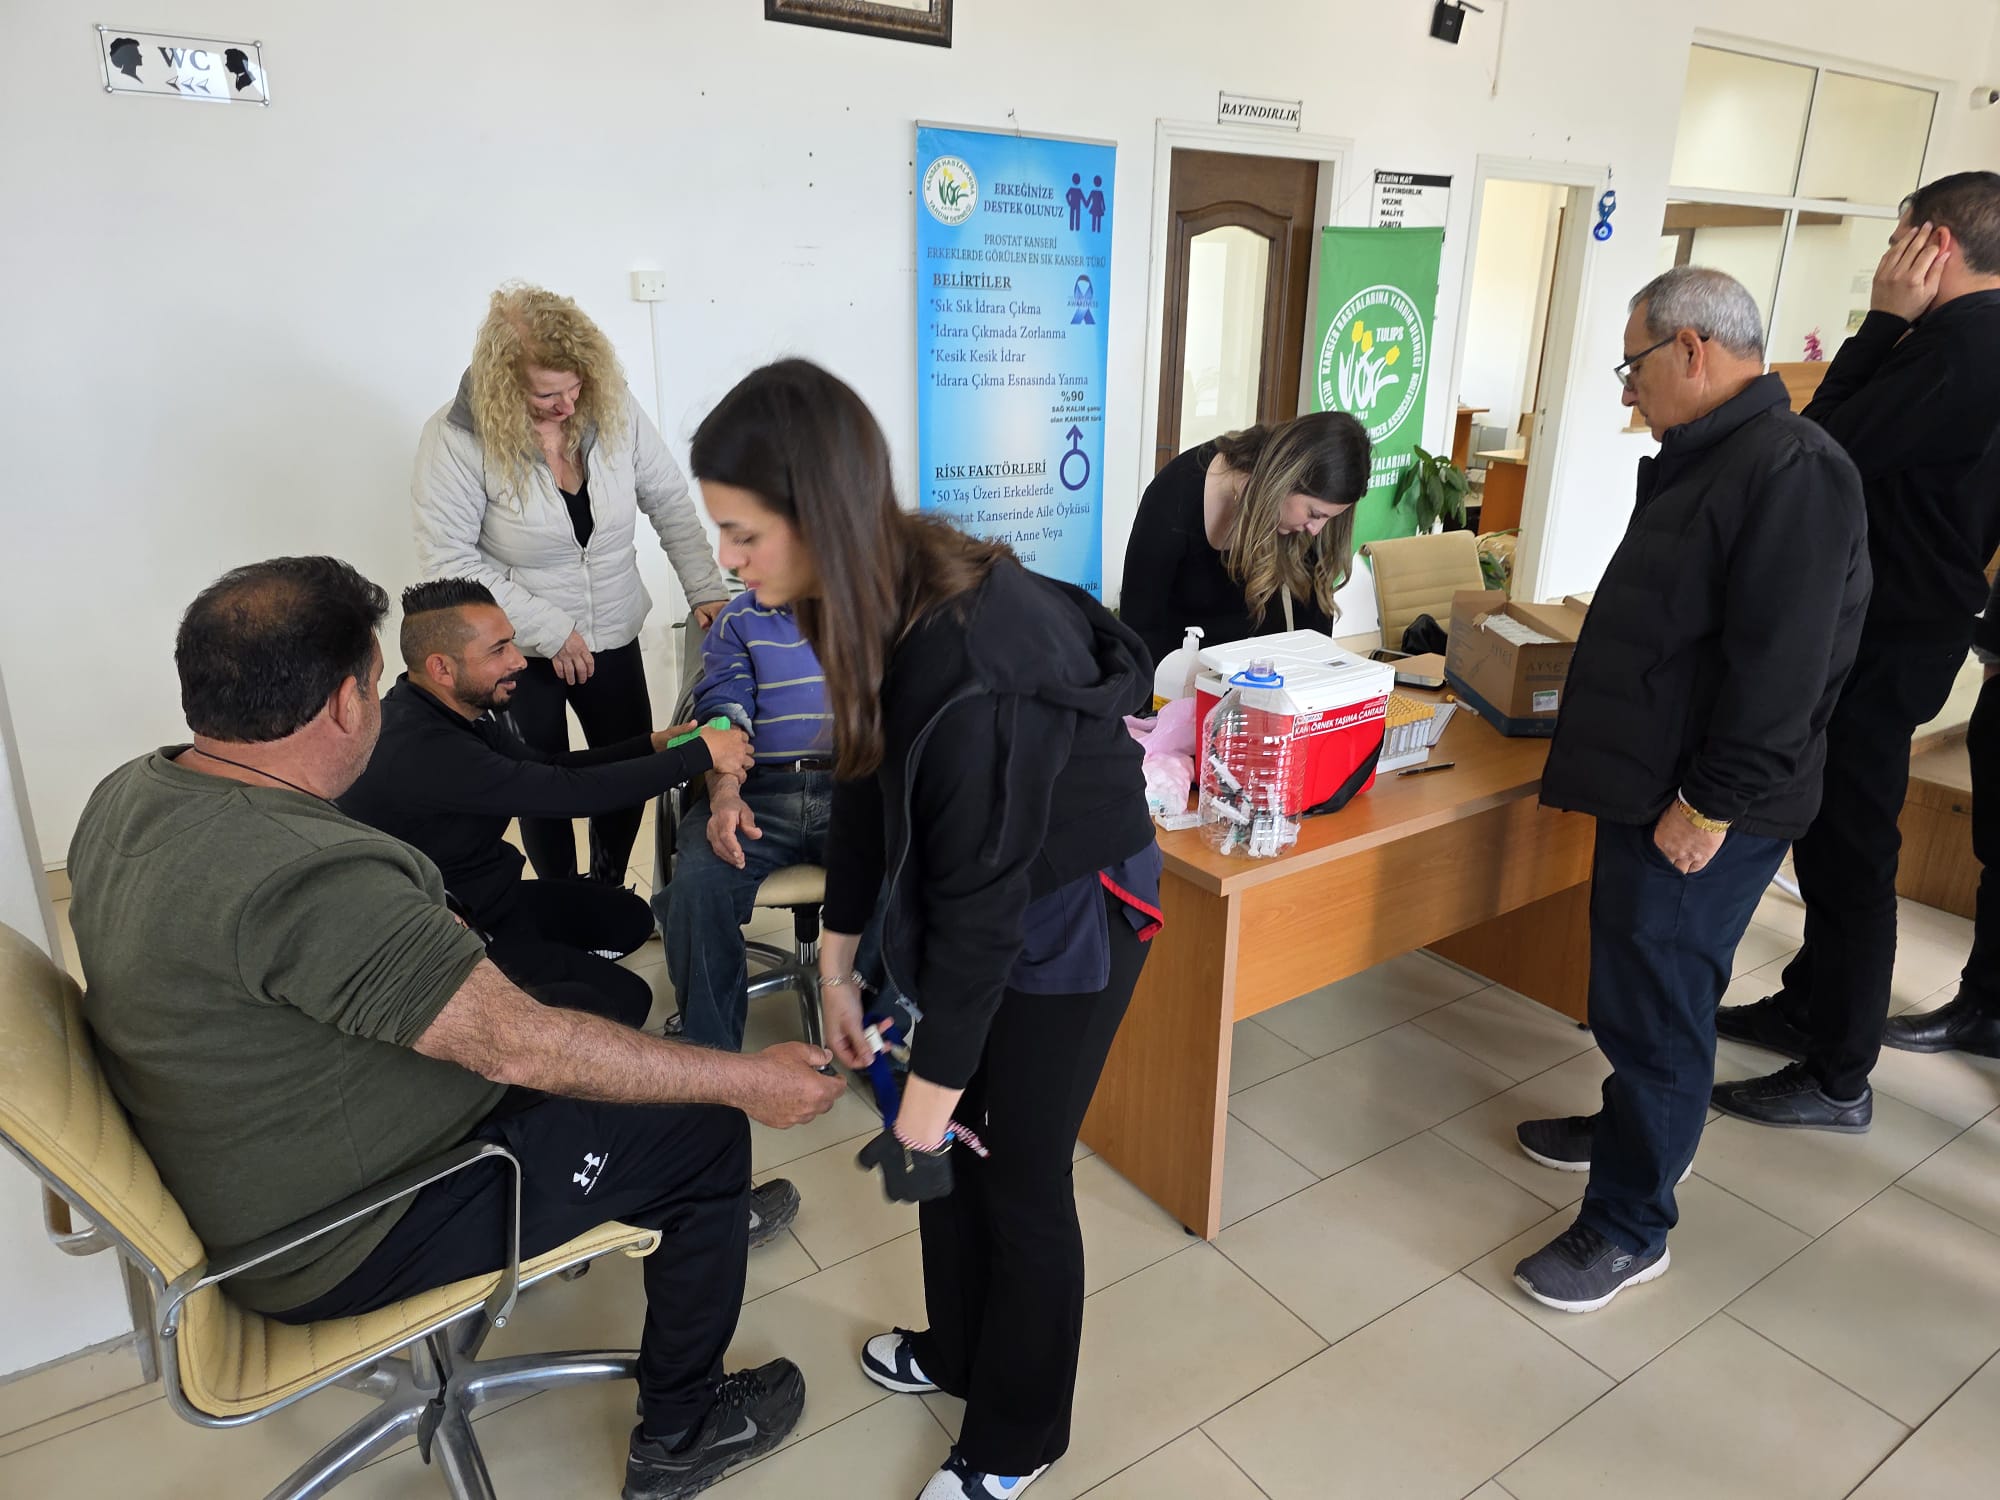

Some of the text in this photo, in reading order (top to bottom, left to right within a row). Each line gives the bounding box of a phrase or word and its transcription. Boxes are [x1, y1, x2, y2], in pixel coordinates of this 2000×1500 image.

[157, 46, 211, 71] WC
[1222, 103, 1298, 121] BAYINDIRLIK
[1399, 175, 1414, 185] KAT
[994, 182, 1054, 200] ERKEĞİNİZE
[983, 202, 1064, 218] DESTEK OLUNUZ
[984, 233, 1057, 250] PROSTAT KANSERİ
[927, 247, 984, 262] ERKEKLERDE
[985, 249, 1027, 264] GÖRÜLEN
[1028, 252, 1039, 264] EN
[1040, 253, 1053, 265] SIK
[1054, 254, 1084, 267] KANSER
[933, 271, 1012, 289] BELİRTİLER
[956, 299, 973, 313] Sık
[975, 298, 1006, 314] İdrara
[1009, 300, 1041, 318] Çıkma
[972, 325, 1017, 342] Çıkmada
[1020, 325, 1066, 340] Zorlanma
[1322, 328, 1341, 375] KANSER
[1336, 291, 1389, 332] HASTALARINA
[1390, 293, 1415, 327] YARDIM
[1376, 326, 1404, 343] TULIPS
[969, 348, 998, 363] Kesik
[1001, 349, 1026, 363] İdrar
[972, 374, 1005, 390] Çıkma
[1008, 373, 1056, 387] Esnasında
[1058, 373, 1088, 386] Yanma
[1061, 390, 1084, 402] %90
[935, 459, 1047, 479] RİSK FAKTÖRLERİ
[1371, 453, 1411, 472] TALARINA
[952, 487, 970, 501] Yaş
[973, 484, 1001, 500] Üzeri
[1003, 485, 1054, 499] Erkeklerde
[977, 507, 1034, 522] Kanserinde
[1036, 505, 1054, 518] Aile
[1056, 502, 1090, 519] Öyküsü
[1015, 530, 1040, 542] Anne
[1042, 527, 1063, 542] Veya
[1310, 719, 1334, 732] ÖRNEK
[1335, 713, 1358, 727] TAŞIMA
[1358, 705, 1385, 721] ÇANTASI
